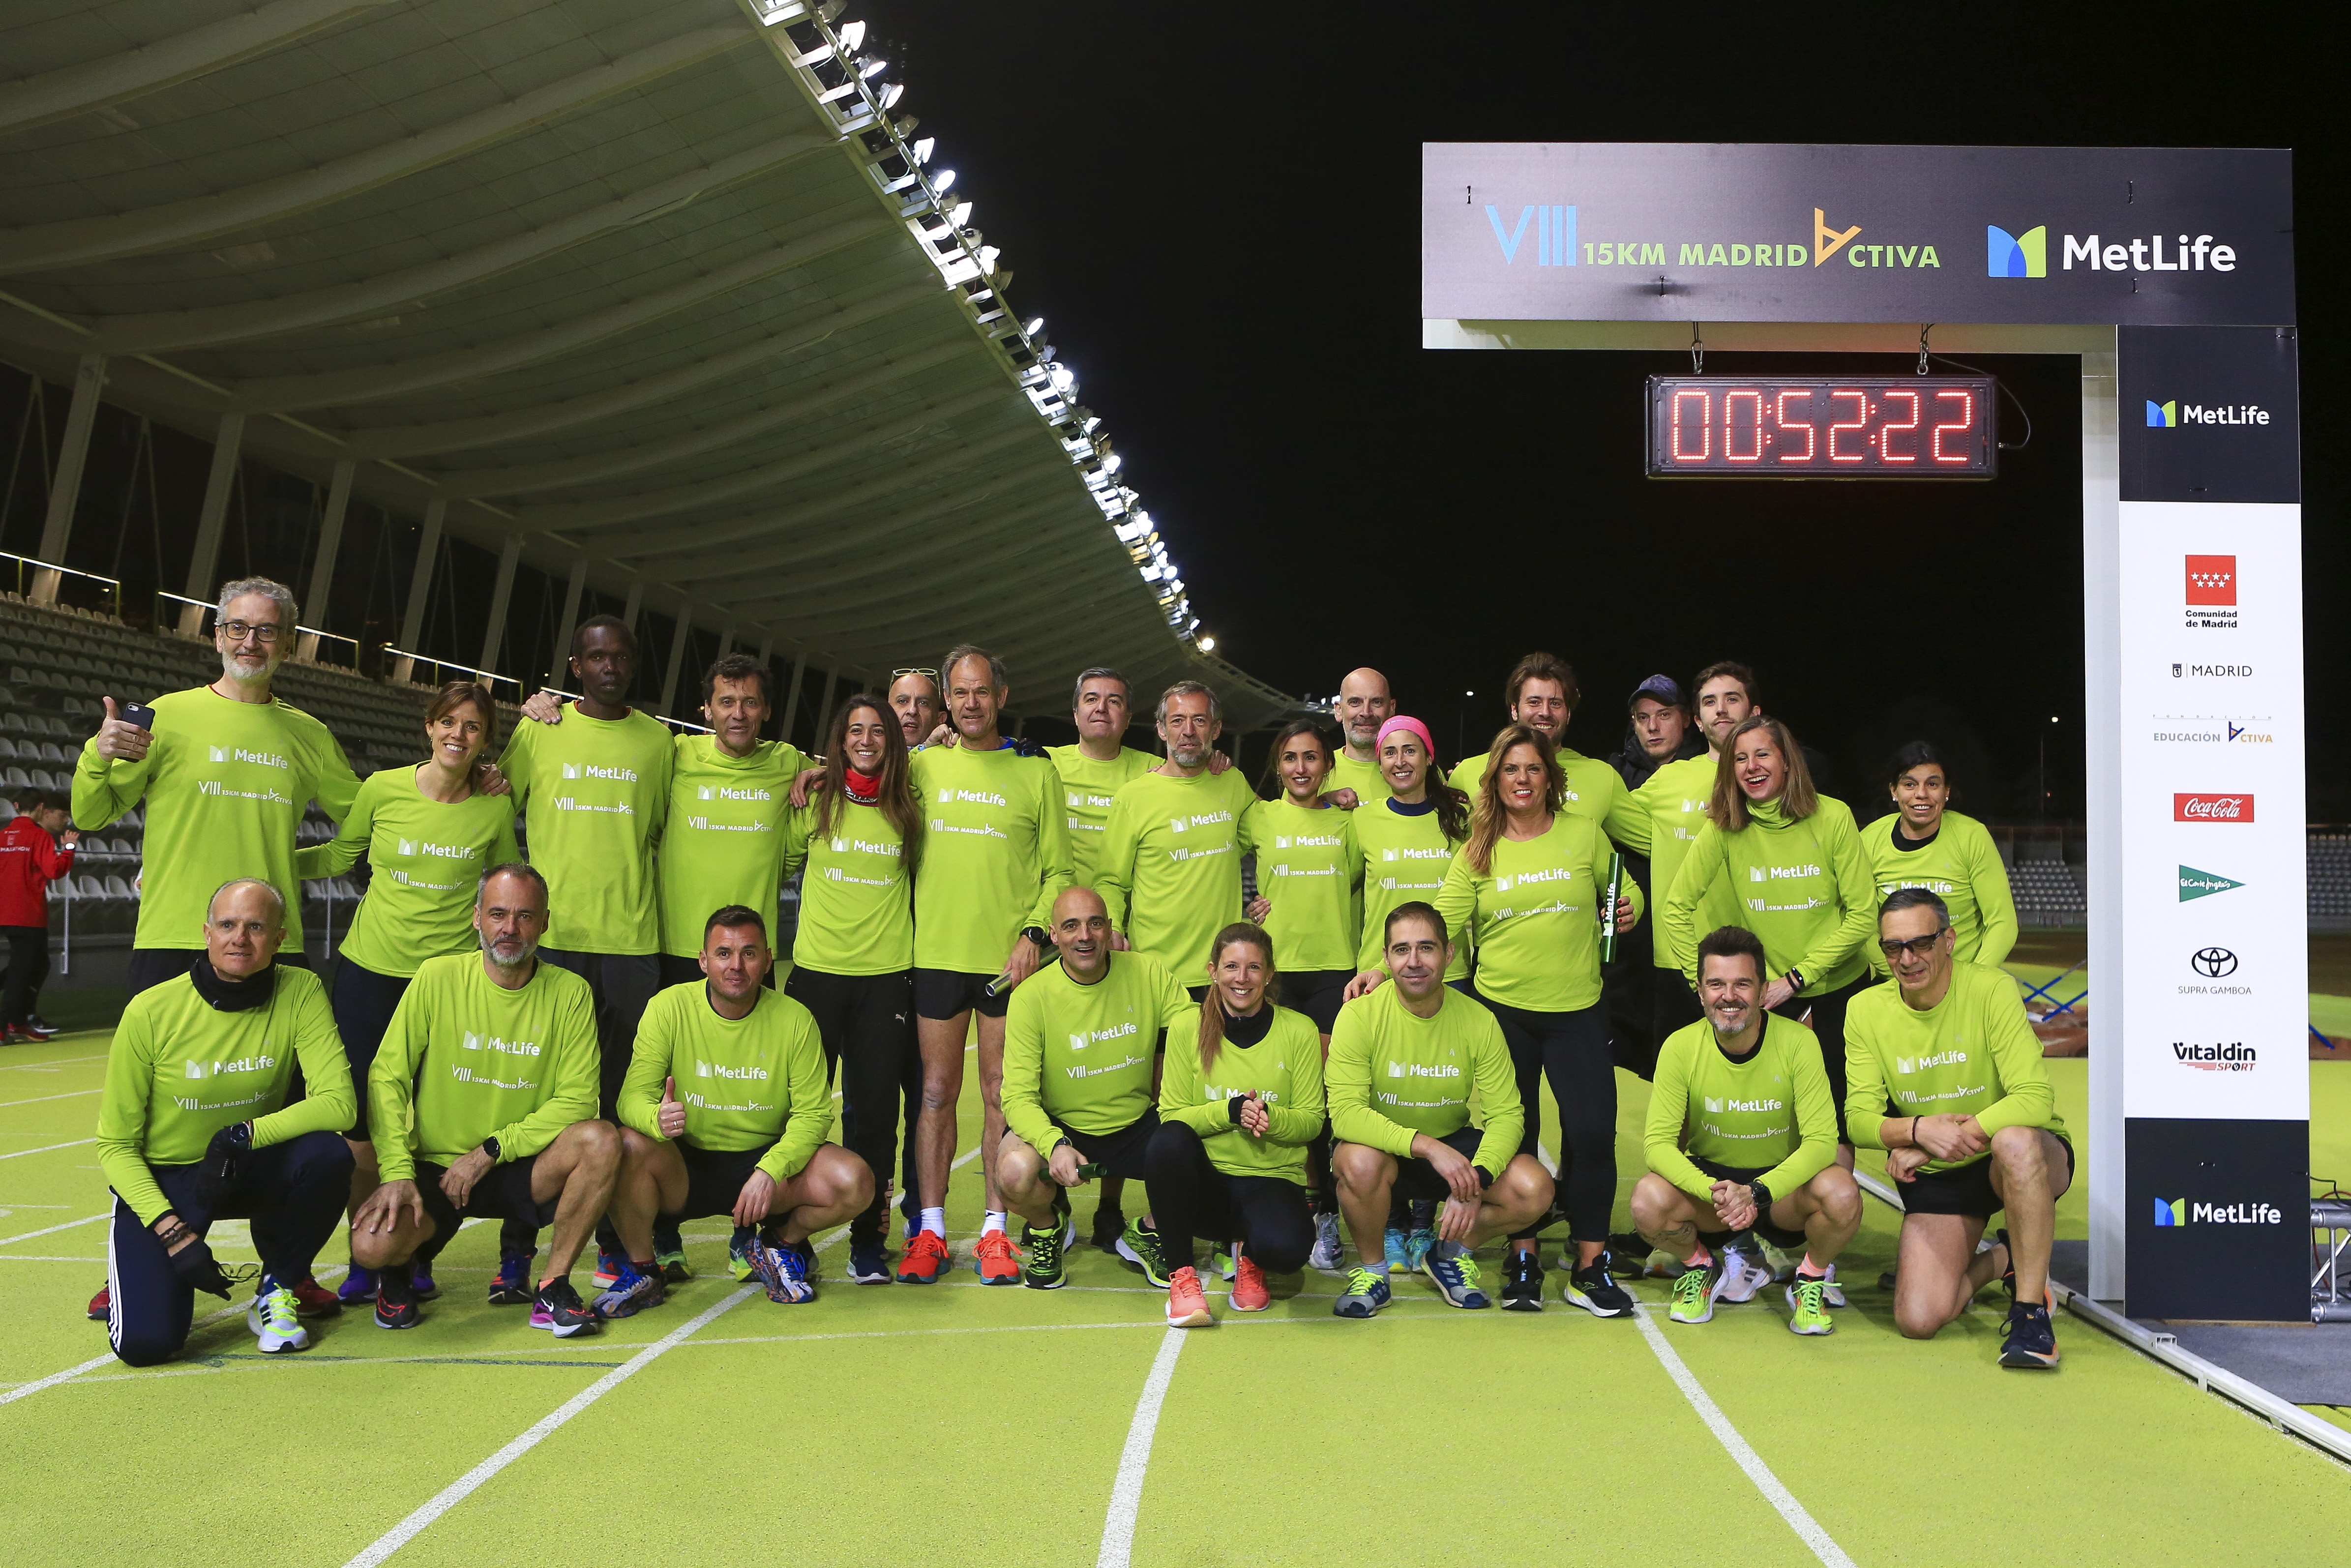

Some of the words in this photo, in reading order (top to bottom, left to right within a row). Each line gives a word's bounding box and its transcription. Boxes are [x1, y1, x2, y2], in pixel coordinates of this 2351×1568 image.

[1485, 205, 1577, 266] VIII
[1584, 243, 1666, 266] 15KM
[1678, 242, 1807, 267] MADRID
[2062, 235, 2236, 273] MetLife
[2183, 404, 2269, 425] MetLife
[1673, 390, 1970, 461] 00:52:22
[2186, 610, 2237, 618] Comunidad
[2202, 620, 2237, 628] Madrid
[2192, 665, 2252, 677] MADRID
[2154, 731, 2221, 742] EDUCACIÓN
[235, 748, 288, 769] MetLife
[586, 765, 637, 782] MetLife
[198, 780, 221, 795] VIII
[241, 791, 267, 800] MADRID
[719, 787, 770, 800] MetLife
[554, 797, 573, 810] VIII
[619, 801, 637, 815] ACTI
[956, 790, 1006, 807] MetLife
[688, 816, 707, 829] VIII
[1067, 817, 1077, 829] III
[1190, 810, 1232, 827] MetLife
[929, 819, 943, 831] VIII
[984, 823, 1008, 839] ACTIVA
[1674, 827, 1686, 840] VIII
[1296, 834, 1341, 846] MetLife
[422, 842, 475, 859] MetLife
[853, 840, 901, 857] MetLife
[1169, 847, 1189, 862] VIII
[1190, 850, 1205, 858] 15KM
[1206, 847, 1226, 856] MADRID
[1403, 848, 1452, 858] MetLife
[389, 868, 408, 884] VIII
[824, 867, 841, 881] VIII
[1270, 864, 1288, 876] VIII
[1518, 868, 1571, 885] MetLife
[1770, 864, 1820, 879] MetLife
[1379, 877, 1396, 889] VIII
[1605, 882, 1616, 920] MetLife
[1746, 898, 1765, 912] VIII
[1493, 907, 1513, 920] VIII
[2178, 986, 2207, 995] SUPRA
[2210, 986, 2252, 995] GAMBOA
[1091, 1022, 1137, 1042] MetLife
[487, 1037, 540, 1056] MetLife
[2173, 1042, 2256, 1061] Vitaldin
[213, 1055, 275, 1075] MetLife
[1919, 1050, 1966, 1070] MetLife
[451, 1064, 472, 1081] VIII
[492, 1079, 516, 1090] MADRID
[518, 1077, 538, 1090] ACTIV
[714, 1064, 767, 1080] MetLife
[1066, 1065, 1086, 1079] VIII
[1088, 1067, 1102, 1076] 15KM
[1104, 1063, 1126, 1072] MADRID
[1409, 1064, 1459, 1077] MetLife
[174, 1095, 198, 1110] VIII
[684, 1091, 703, 1108] VIII
[1226, 1088, 1279, 1102] Mife
[1377, 1092, 1397, 1105] VIII
[1897, 1090, 1917, 1103] VIII
[1919, 1094, 1936, 1103] 15KM
[1728, 1099, 1782, 1112] MetLife
[1701, 1120, 1720, 1136] VIII
[2193, 1203, 2281, 1224] MetLife
